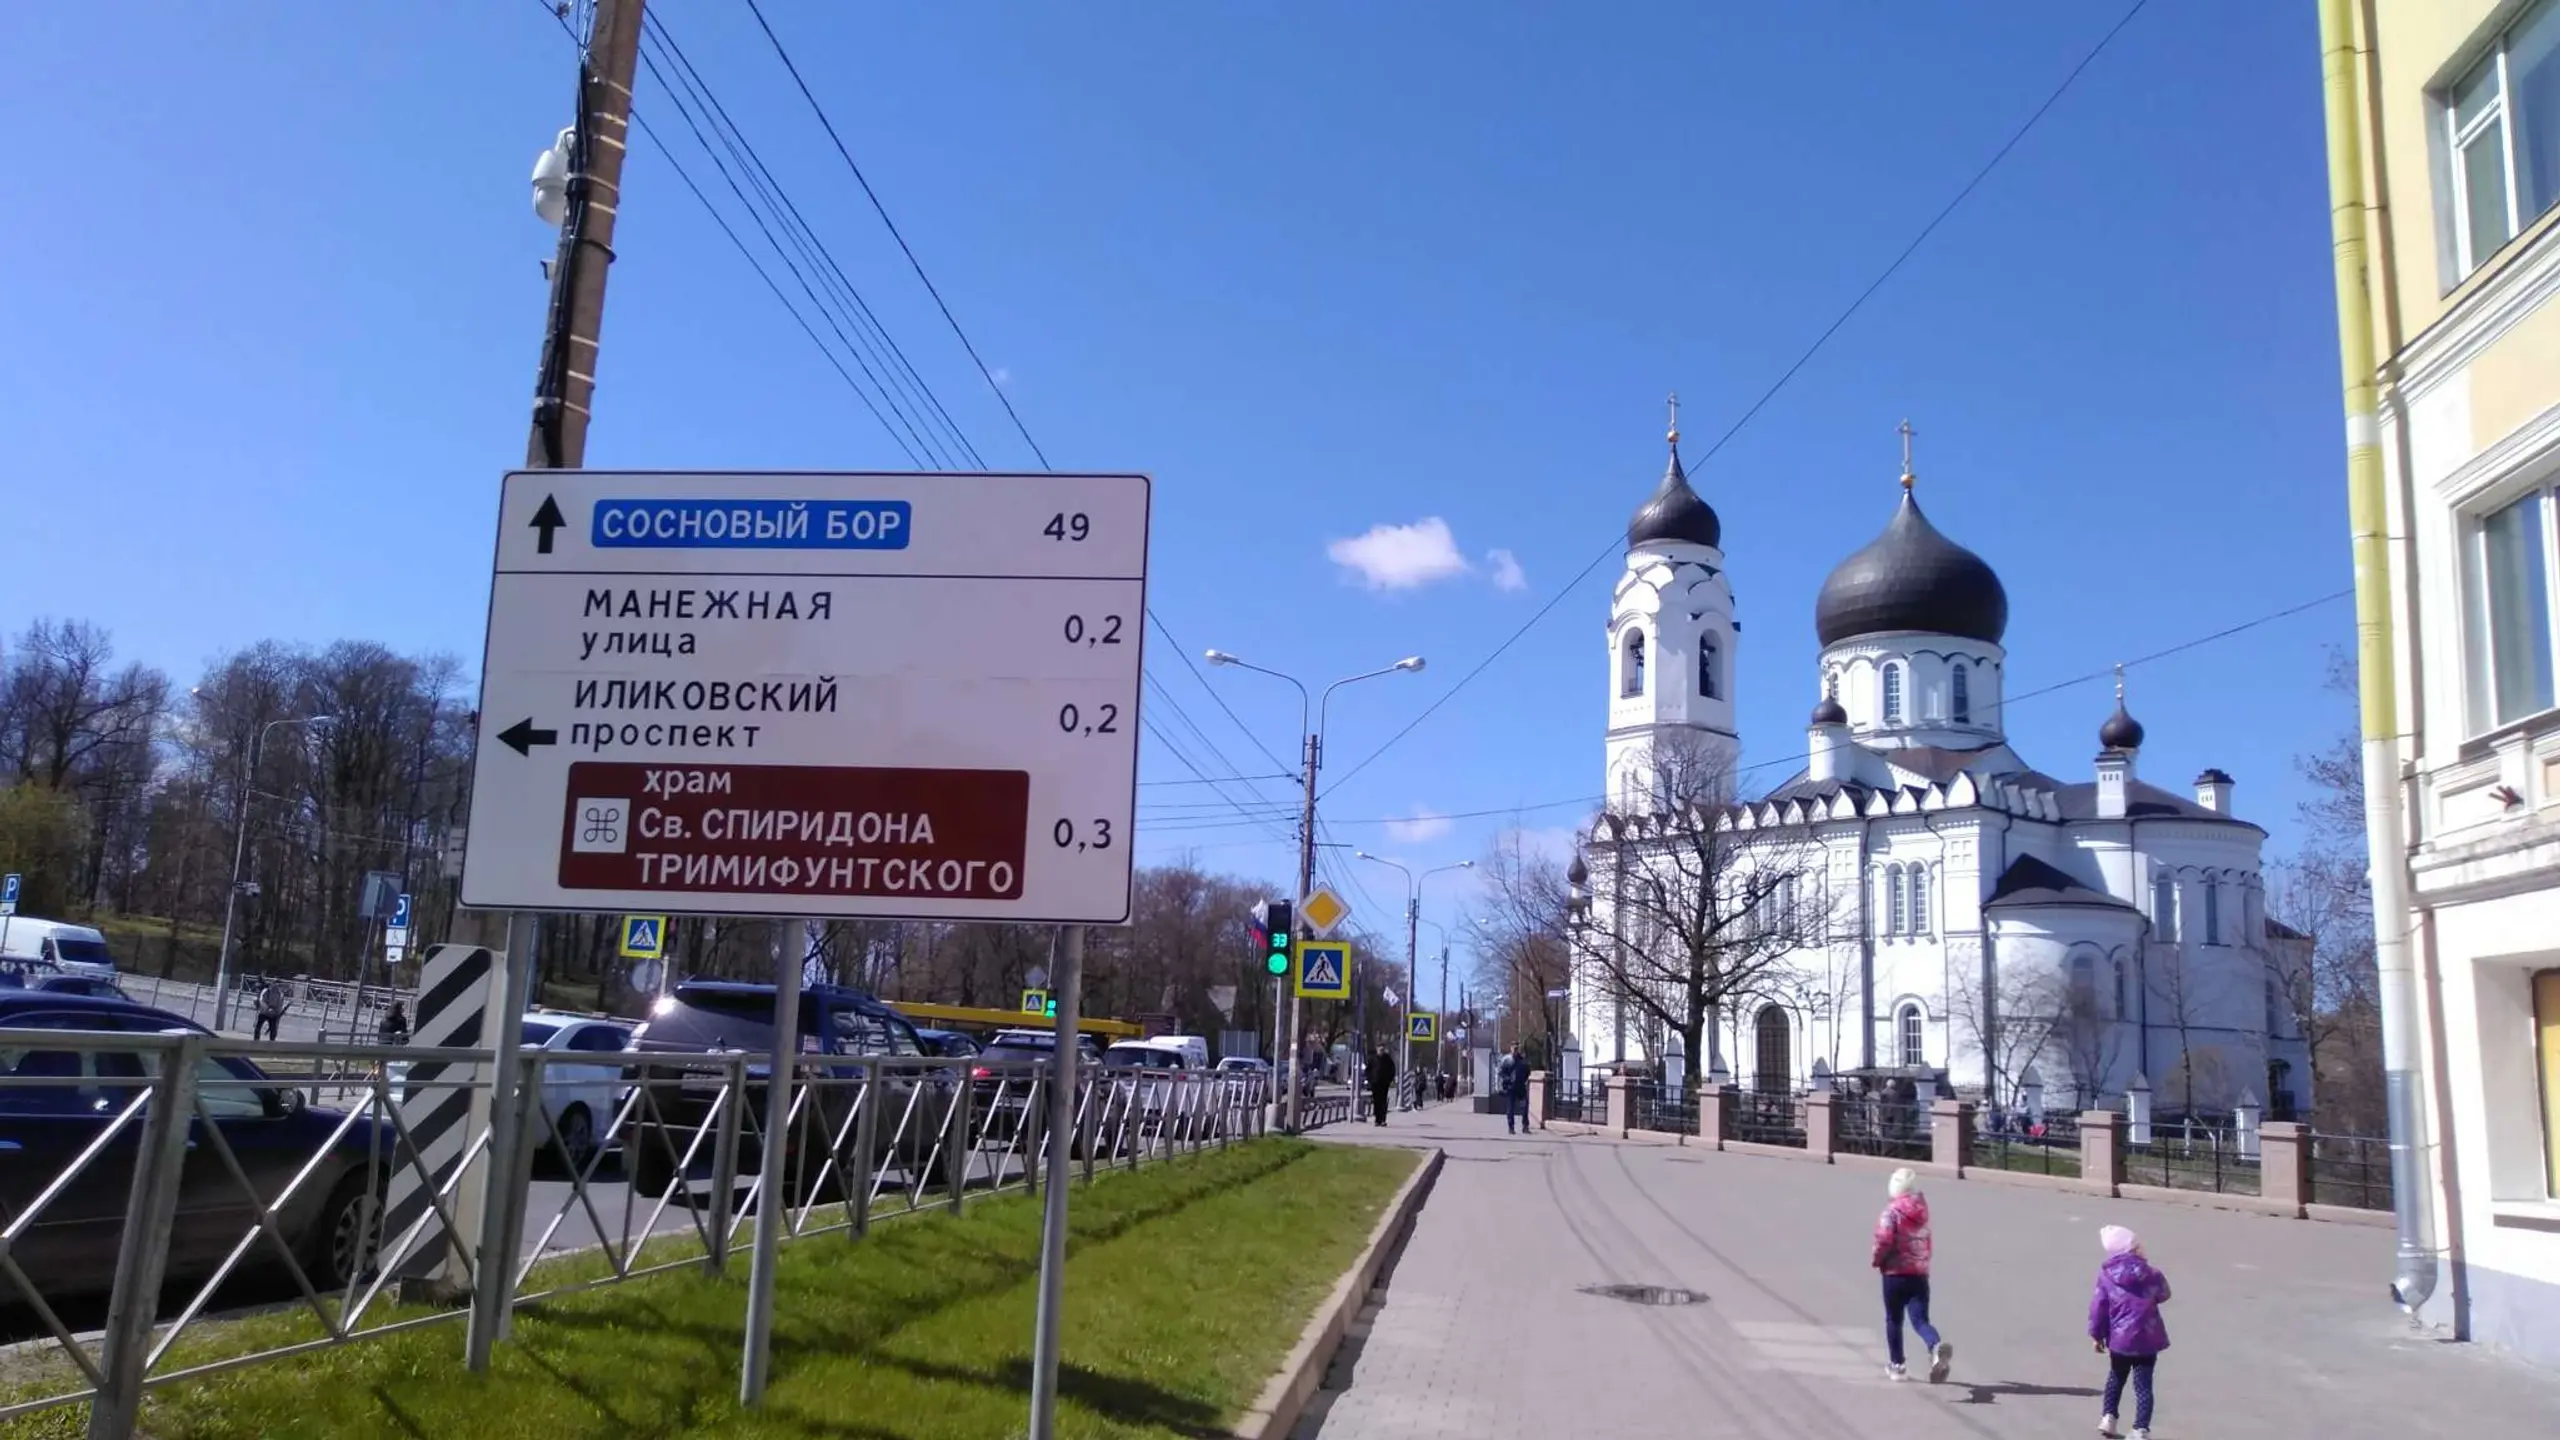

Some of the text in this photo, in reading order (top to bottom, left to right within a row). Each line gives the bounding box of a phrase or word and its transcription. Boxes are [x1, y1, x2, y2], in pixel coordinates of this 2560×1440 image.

[602, 502, 902, 541] СОСНОВЫЙ БОР
[1043, 512, 1090, 542] 49
[583, 589, 833, 620] МАНЕЖНАЯ
[1064, 614, 1122, 646] 0,2
[580, 632, 697, 662] улица
[574, 675, 838, 713] ИЛИКОВСКИЙ
[1059, 703, 1118, 737] 0,2
[571, 723, 762, 754] проспект
[643, 770, 732, 801] храм
[639, 807, 936, 847] Св. СПИРИДОНА
[1053, 818, 1113, 854] 0,3
[635, 853, 1014, 893] ТРИМИФУНТСКОГО
